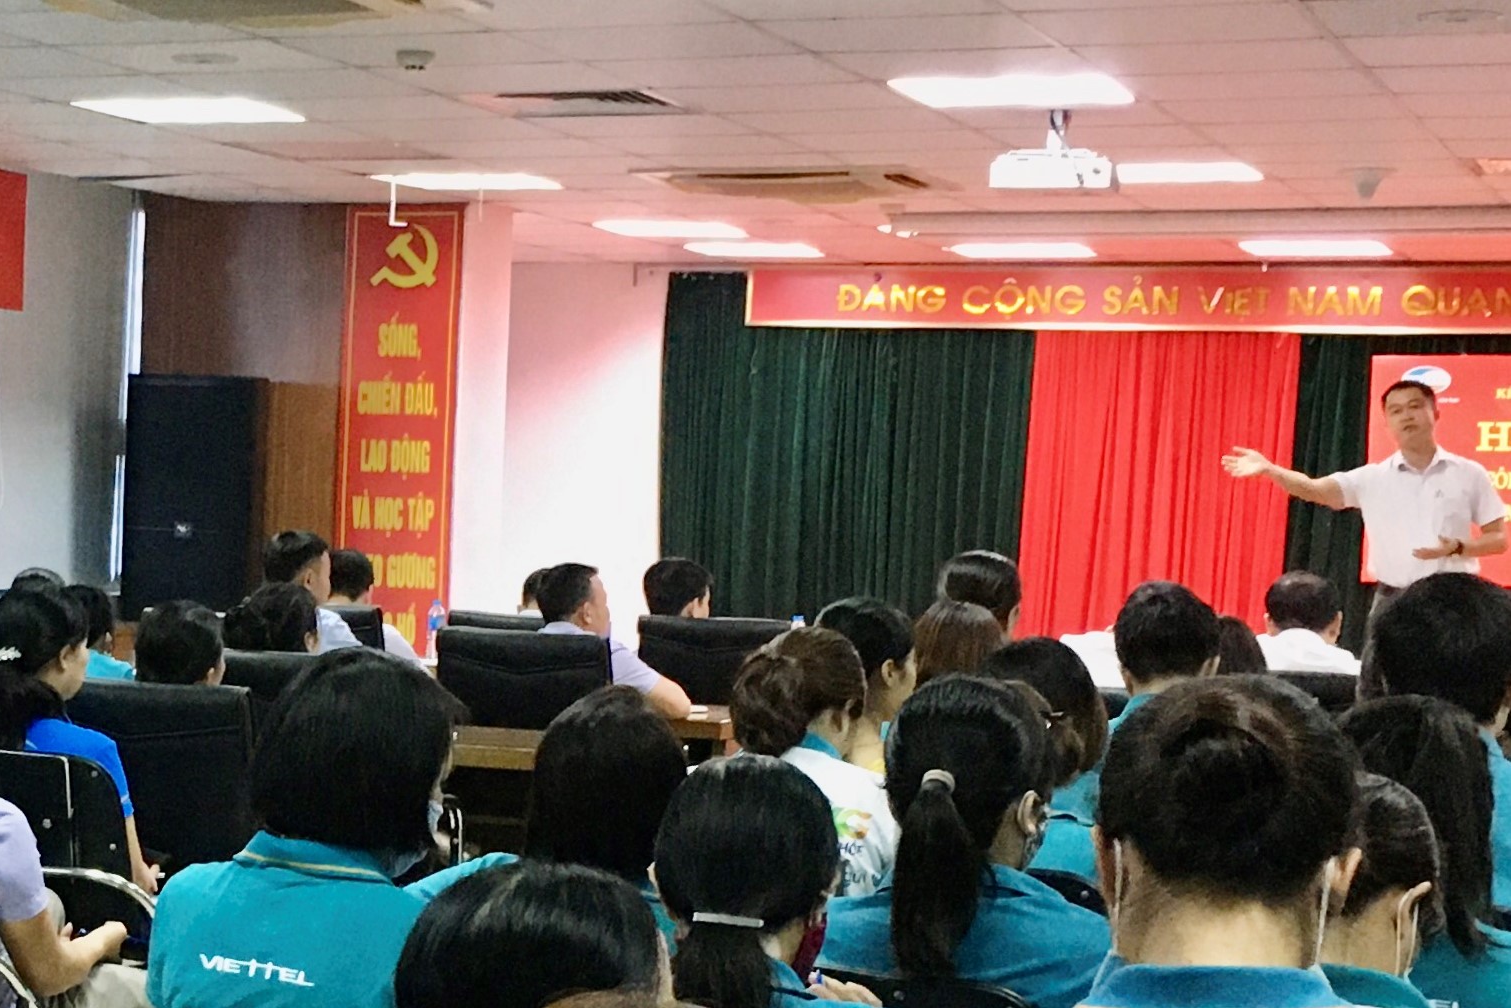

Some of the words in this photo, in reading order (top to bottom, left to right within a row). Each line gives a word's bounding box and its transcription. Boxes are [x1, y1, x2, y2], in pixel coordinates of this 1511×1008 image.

[962, 278, 1086, 319] CỘNG
[1102, 275, 1180, 317] SẢN
[1287, 285, 1383, 317] NAM
[378, 311, 422, 360] SỐNG,
[357, 371, 401, 415] CHIẾN
[405, 371, 438, 419] ĐẤU,
[360, 438, 388, 473] LAO
[391, 433, 431, 480] ĐỘNG
[352, 489, 371, 530] VÀ
[374, 496, 404, 538] HỌC
[408, 492, 435, 539] TẬP
[199, 953, 315, 987] VIETTEL
